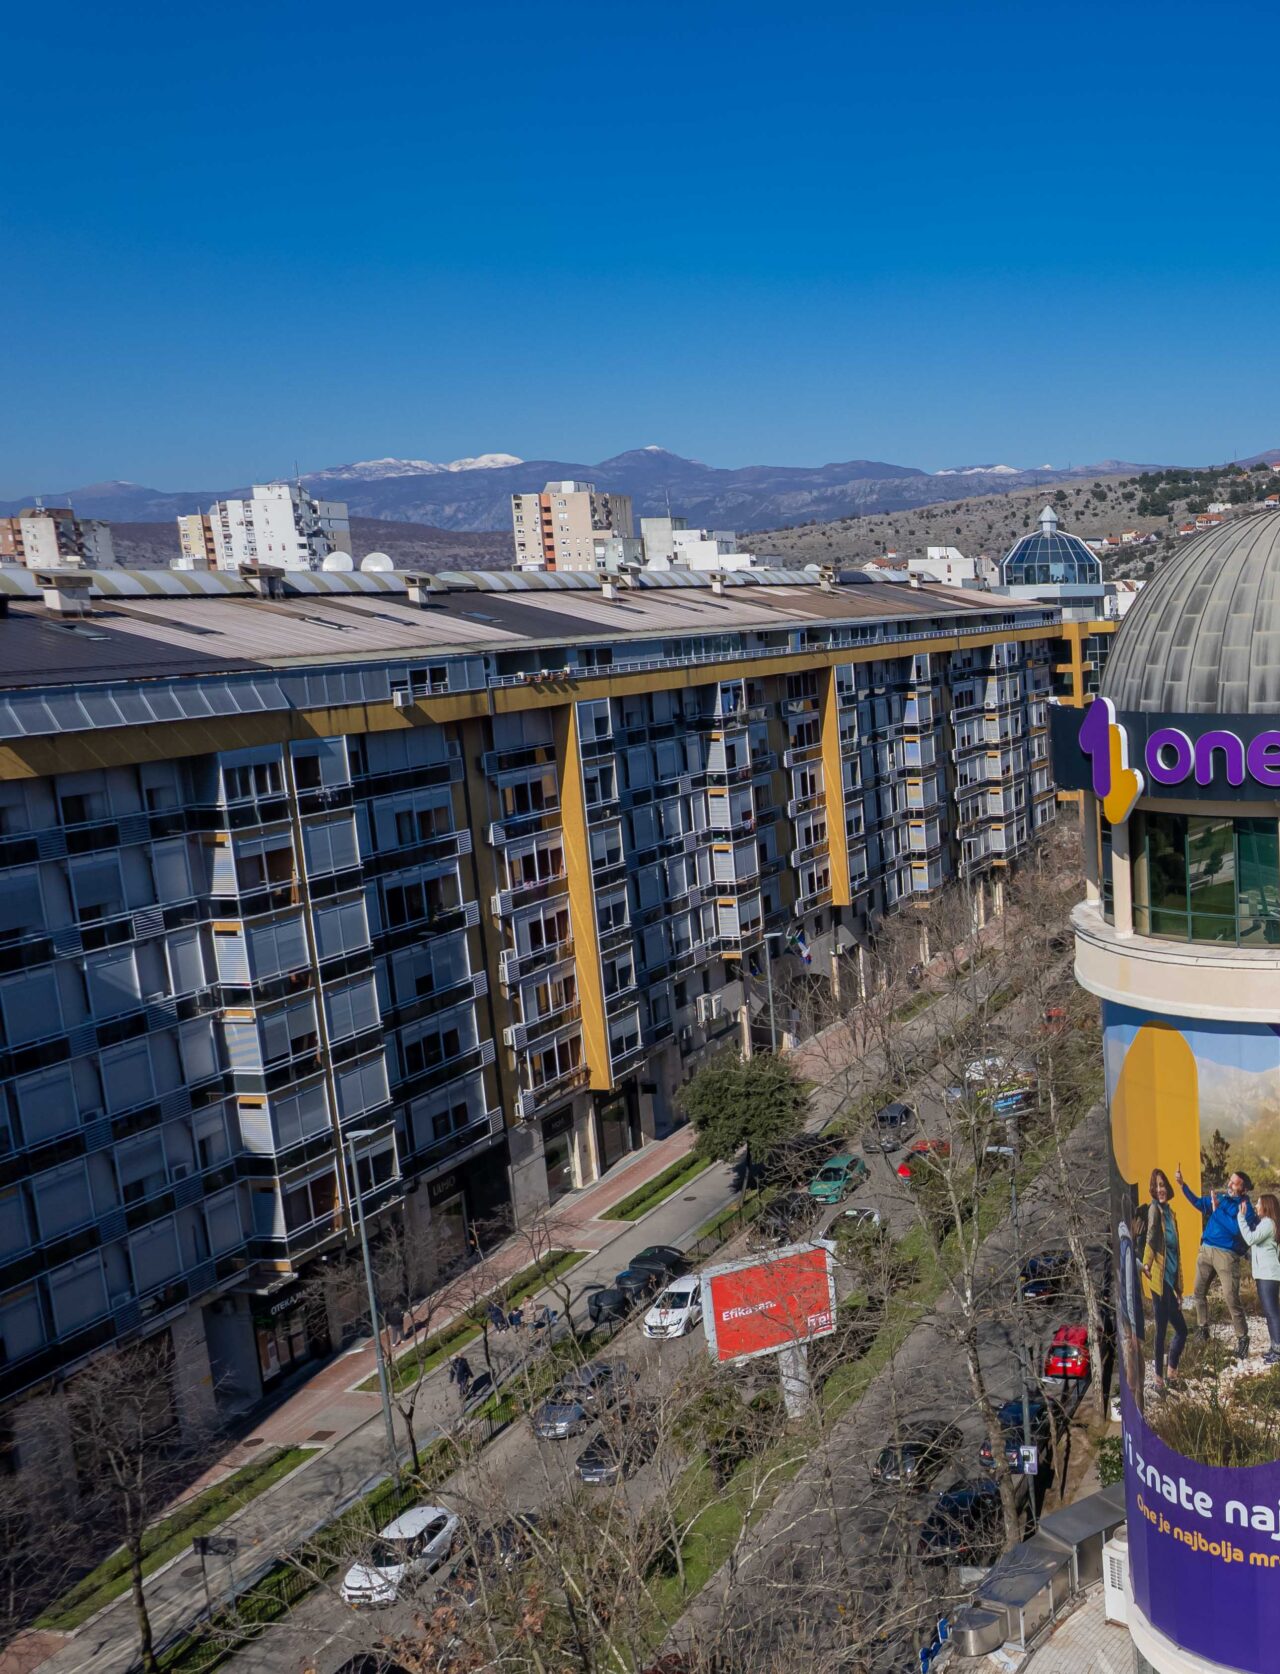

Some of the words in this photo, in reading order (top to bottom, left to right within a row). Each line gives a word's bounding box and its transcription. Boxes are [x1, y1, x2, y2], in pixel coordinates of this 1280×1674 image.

[1135, 1451, 1213, 1518] znate
[1136, 1493, 1157, 1525] One
[1158, 1511, 1171, 1535] je
[1173, 1527, 1245, 1563] najbolja
